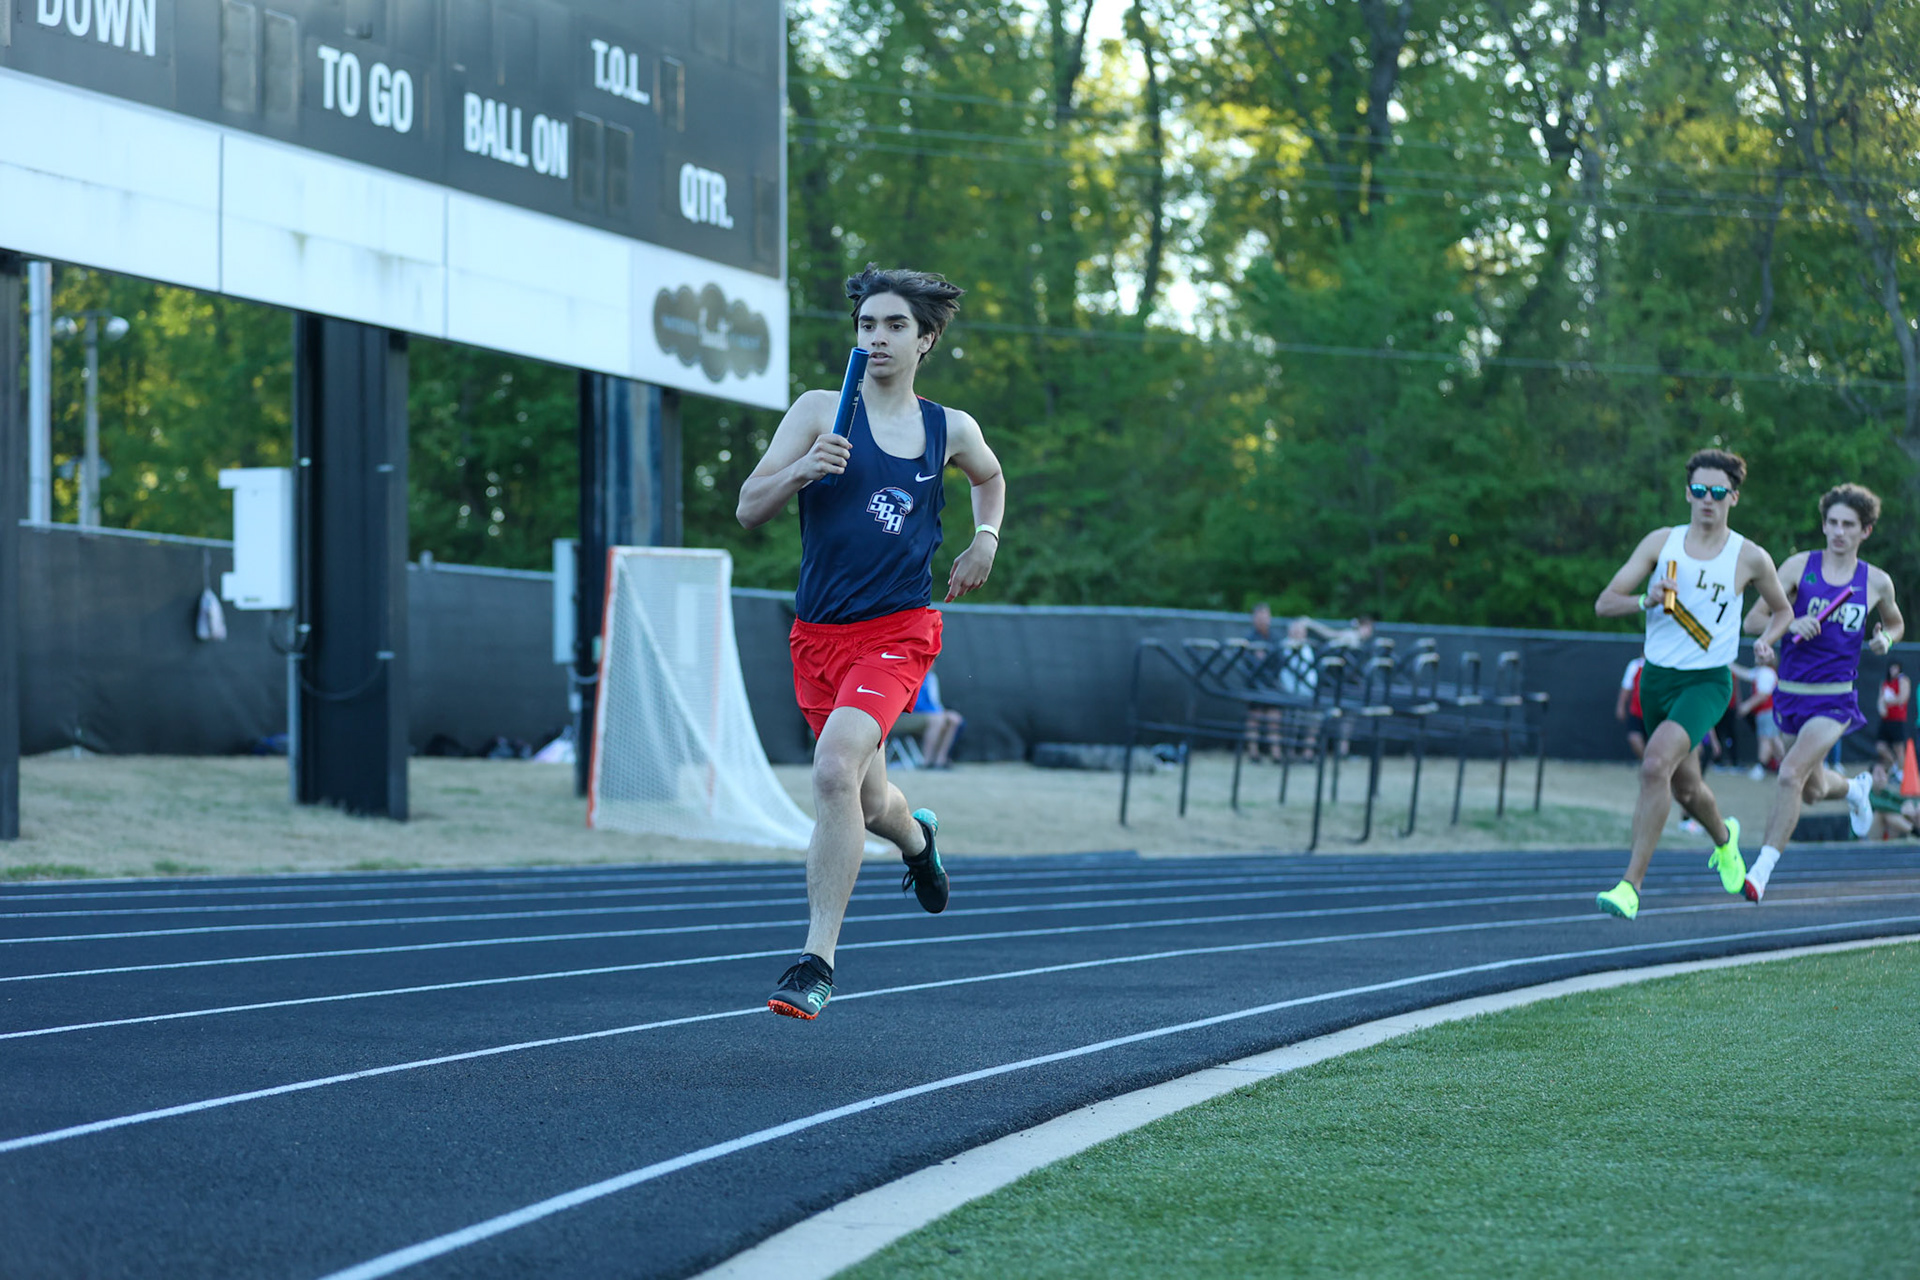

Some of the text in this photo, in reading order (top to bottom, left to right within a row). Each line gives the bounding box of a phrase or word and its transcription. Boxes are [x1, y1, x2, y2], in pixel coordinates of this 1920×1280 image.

[318, 44, 414, 134] TO GO
[464, 91, 568, 180] BALL ON
[679, 162, 734, 230] QTR.
[869, 494, 904, 532] SBA
[1716, 601, 1728, 623] 1
[1847, 606, 1860, 629] 2
